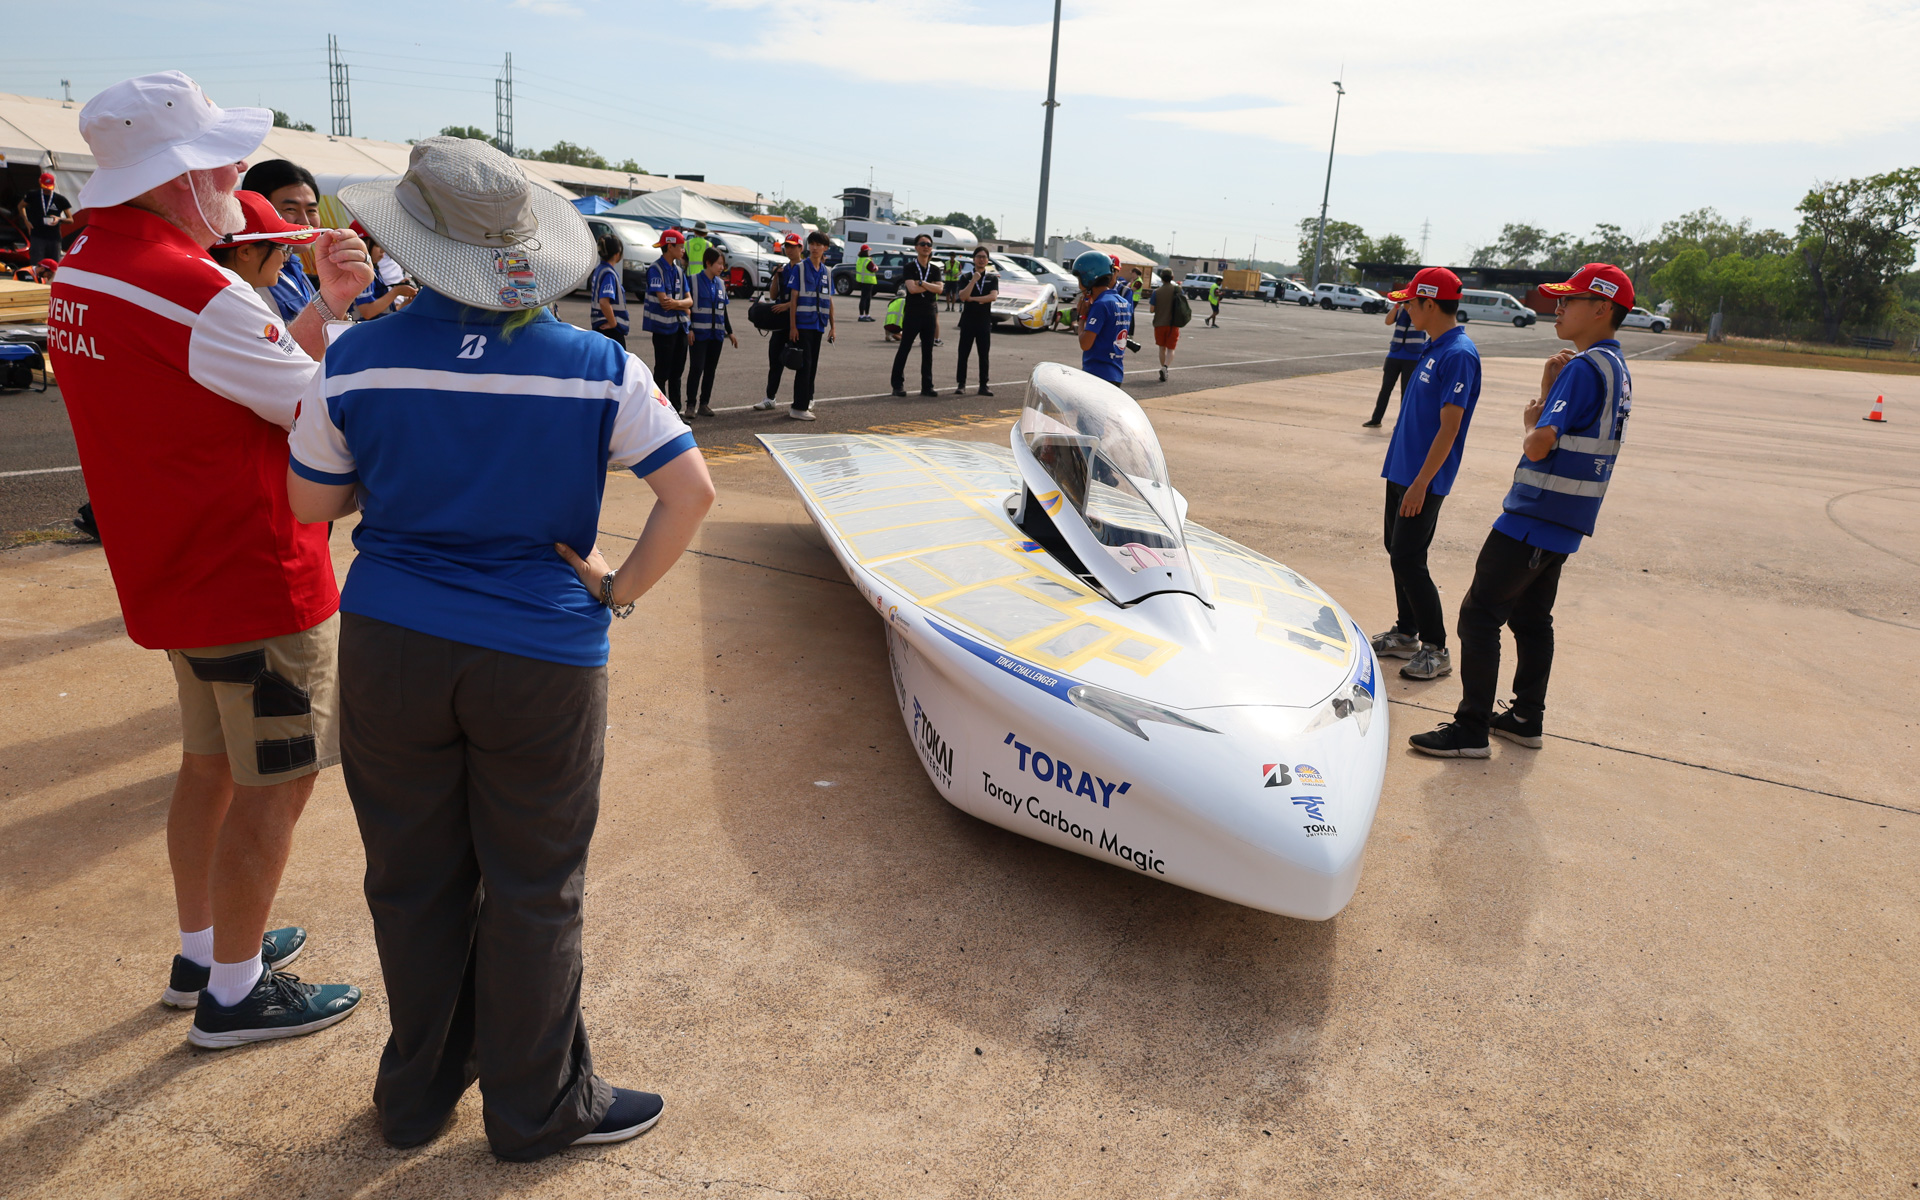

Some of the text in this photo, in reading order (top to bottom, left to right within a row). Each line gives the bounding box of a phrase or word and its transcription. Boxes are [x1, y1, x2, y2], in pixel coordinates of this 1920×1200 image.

[48, 296, 89, 327] VENT
[47, 325, 106, 361] FFICIAL
[995, 655, 1058, 688] TOKAI CHALLENGER
[921, 709, 954, 777] TOKAI
[918, 739, 952, 790] UNIVERSITY
[982, 771, 1165, 875] Toray Carbon Magic
[1303, 824, 1337, 833] TOKAI
